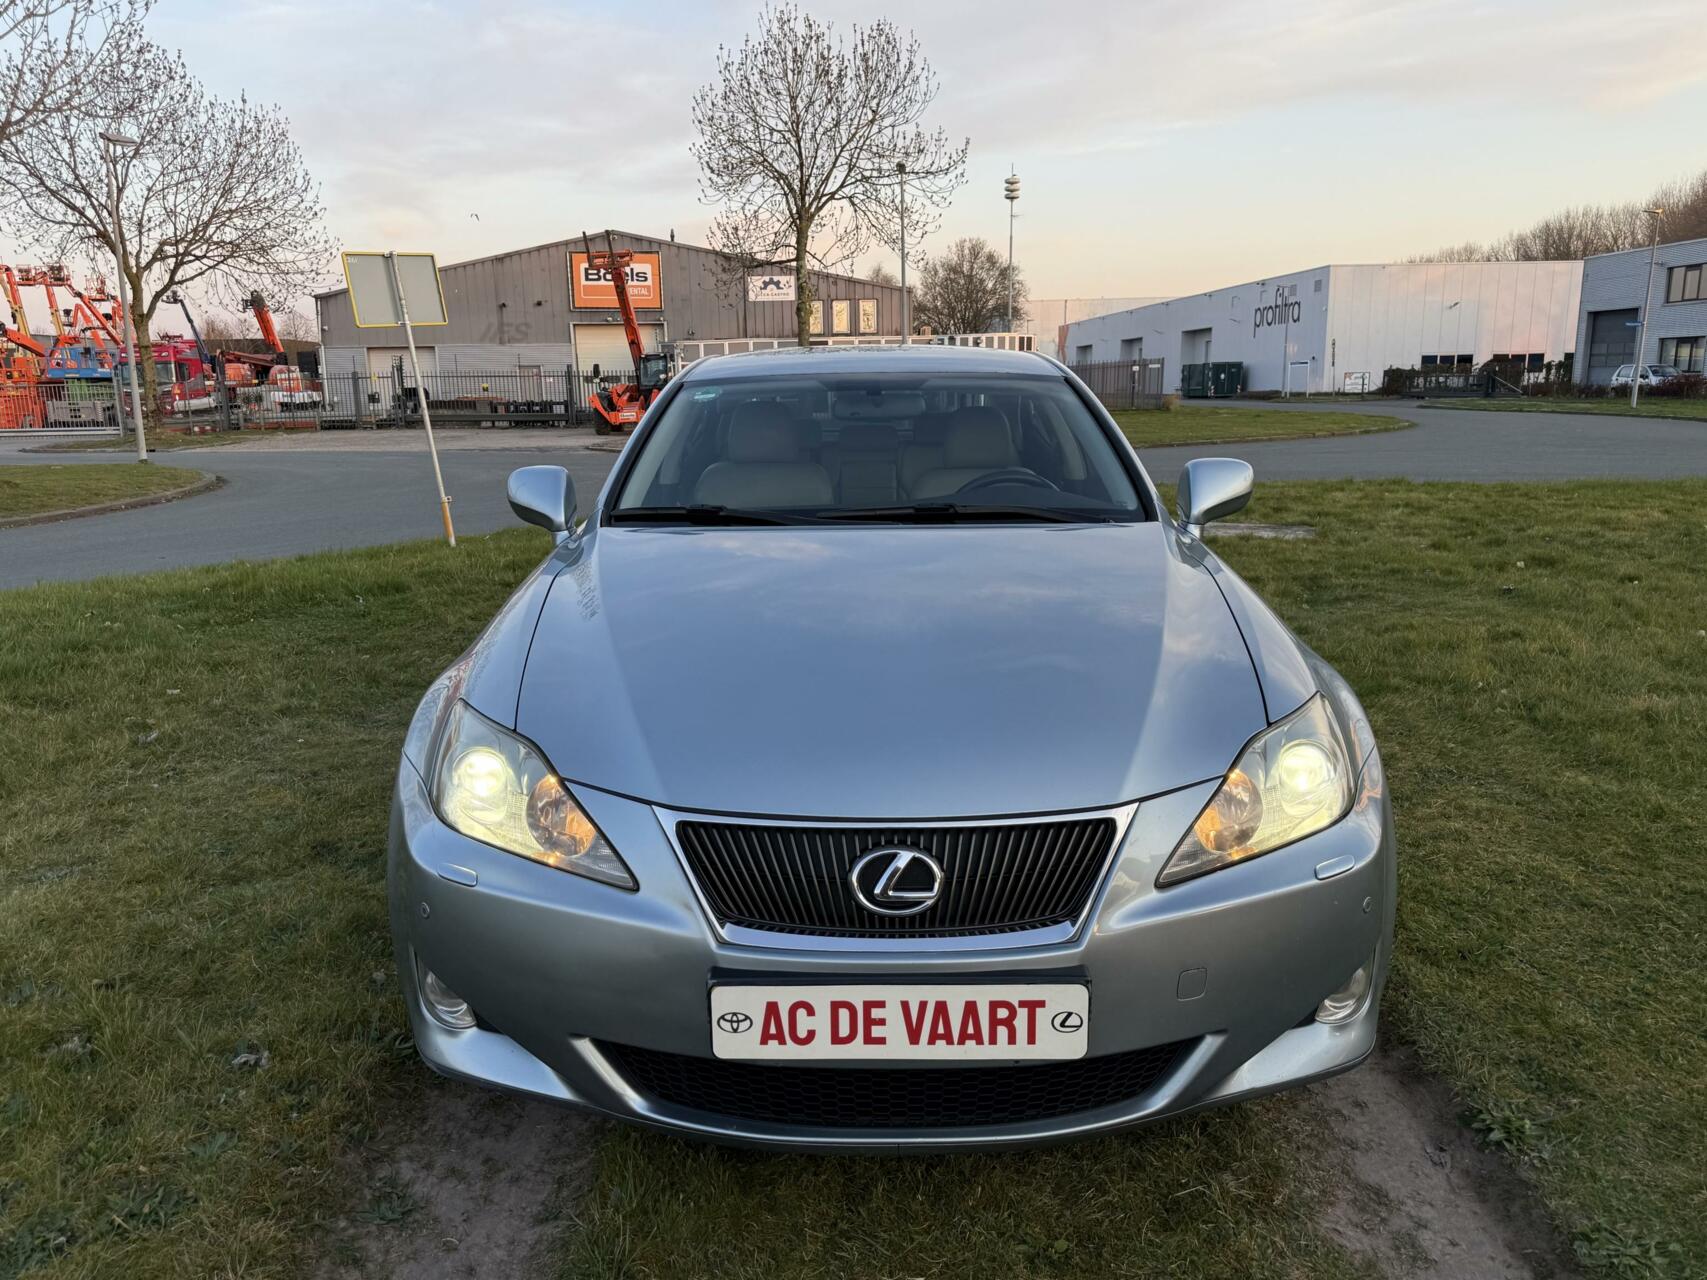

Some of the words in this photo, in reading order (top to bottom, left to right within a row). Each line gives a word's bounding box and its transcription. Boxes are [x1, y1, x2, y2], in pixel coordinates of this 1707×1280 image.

[1253, 287, 1302, 338] profiltra
[759, 1000, 816, 1046] AC
[829, 1000, 887, 1046] DE
[900, 1000, 1046, 1046] VAART
